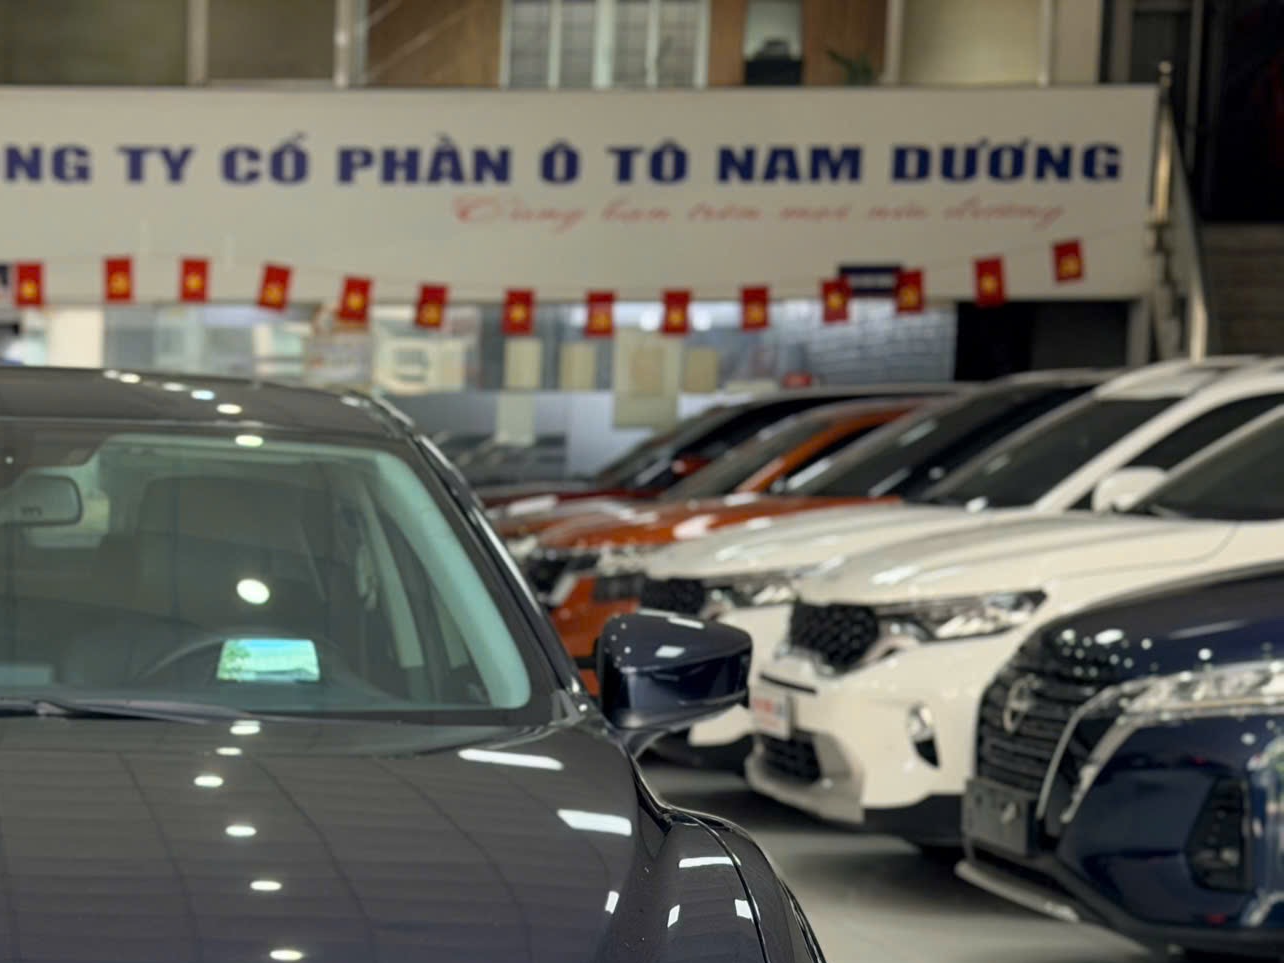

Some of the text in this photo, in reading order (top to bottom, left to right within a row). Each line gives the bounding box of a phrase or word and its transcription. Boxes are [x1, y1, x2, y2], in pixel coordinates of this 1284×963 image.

[118, 144, 193, 183] TY
[539, 138, 580, 184] Ô
[607, 139, 689, 184] TÔ
[716, 145, 862, 183] NAM
[889, 138, 1123, 183] DƯƠNG
